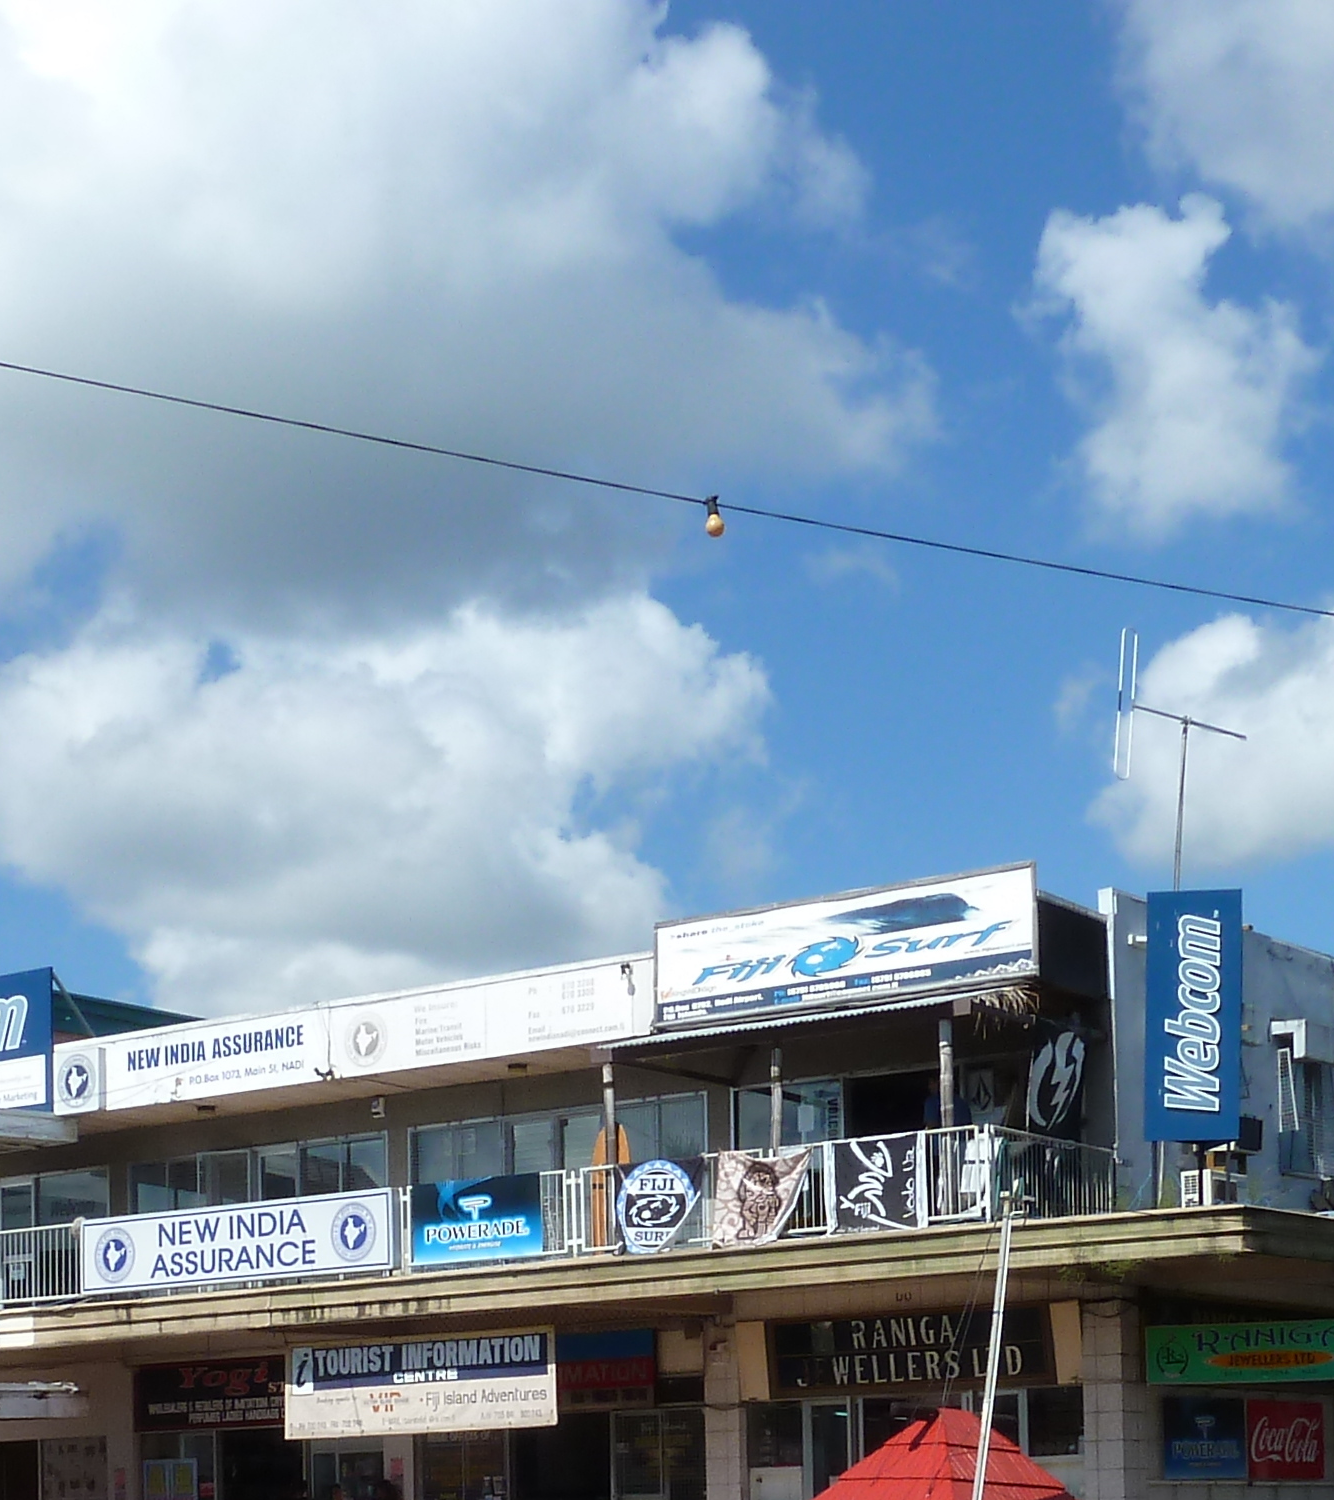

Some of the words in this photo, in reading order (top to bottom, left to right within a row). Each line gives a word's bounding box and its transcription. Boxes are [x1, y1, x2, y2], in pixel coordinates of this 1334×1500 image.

[692, 953, 787, 986] Fiji
[865, 919, 1014, 959] Surf
[1164, 914, 1221, 1112] Webcom
[127, 1047, 160, 1072] NEW
[165, 1041, 206, 1066] INDIA
[212, 1024, 304, 1059] ASSURANCE
[244, 1066, 266, 1078] Main
[282, 1059, 305, 1072] NADI
[639, 1178, 675, 1191] FIJI
[158, 1217, 221, 1247] NEW
[229, 1209, 306, 1240] INDIA
[425, 1220, 529, 1244] POWERADE
[150, 1239, 316, 1279] ASSURANCE
[851, 1315, 956, 1349] RANIGA
[316, 1345, 394, 1377] TOURIST
[401, 1335, 541, 1370] INFORMATION
[972, 1344, 1023, 1377] LD
[1229, 1353, 1291, 1367] JEWELLERS
[1294, 1352, 1315, 1365] LTD
[393, 1369, 458, 1384] CENTRE
[425, 1392, 440, 1411] Fiji
[443, 1390, 477, 1406] Island
[481, 1388, 547, 1404] Adventures
